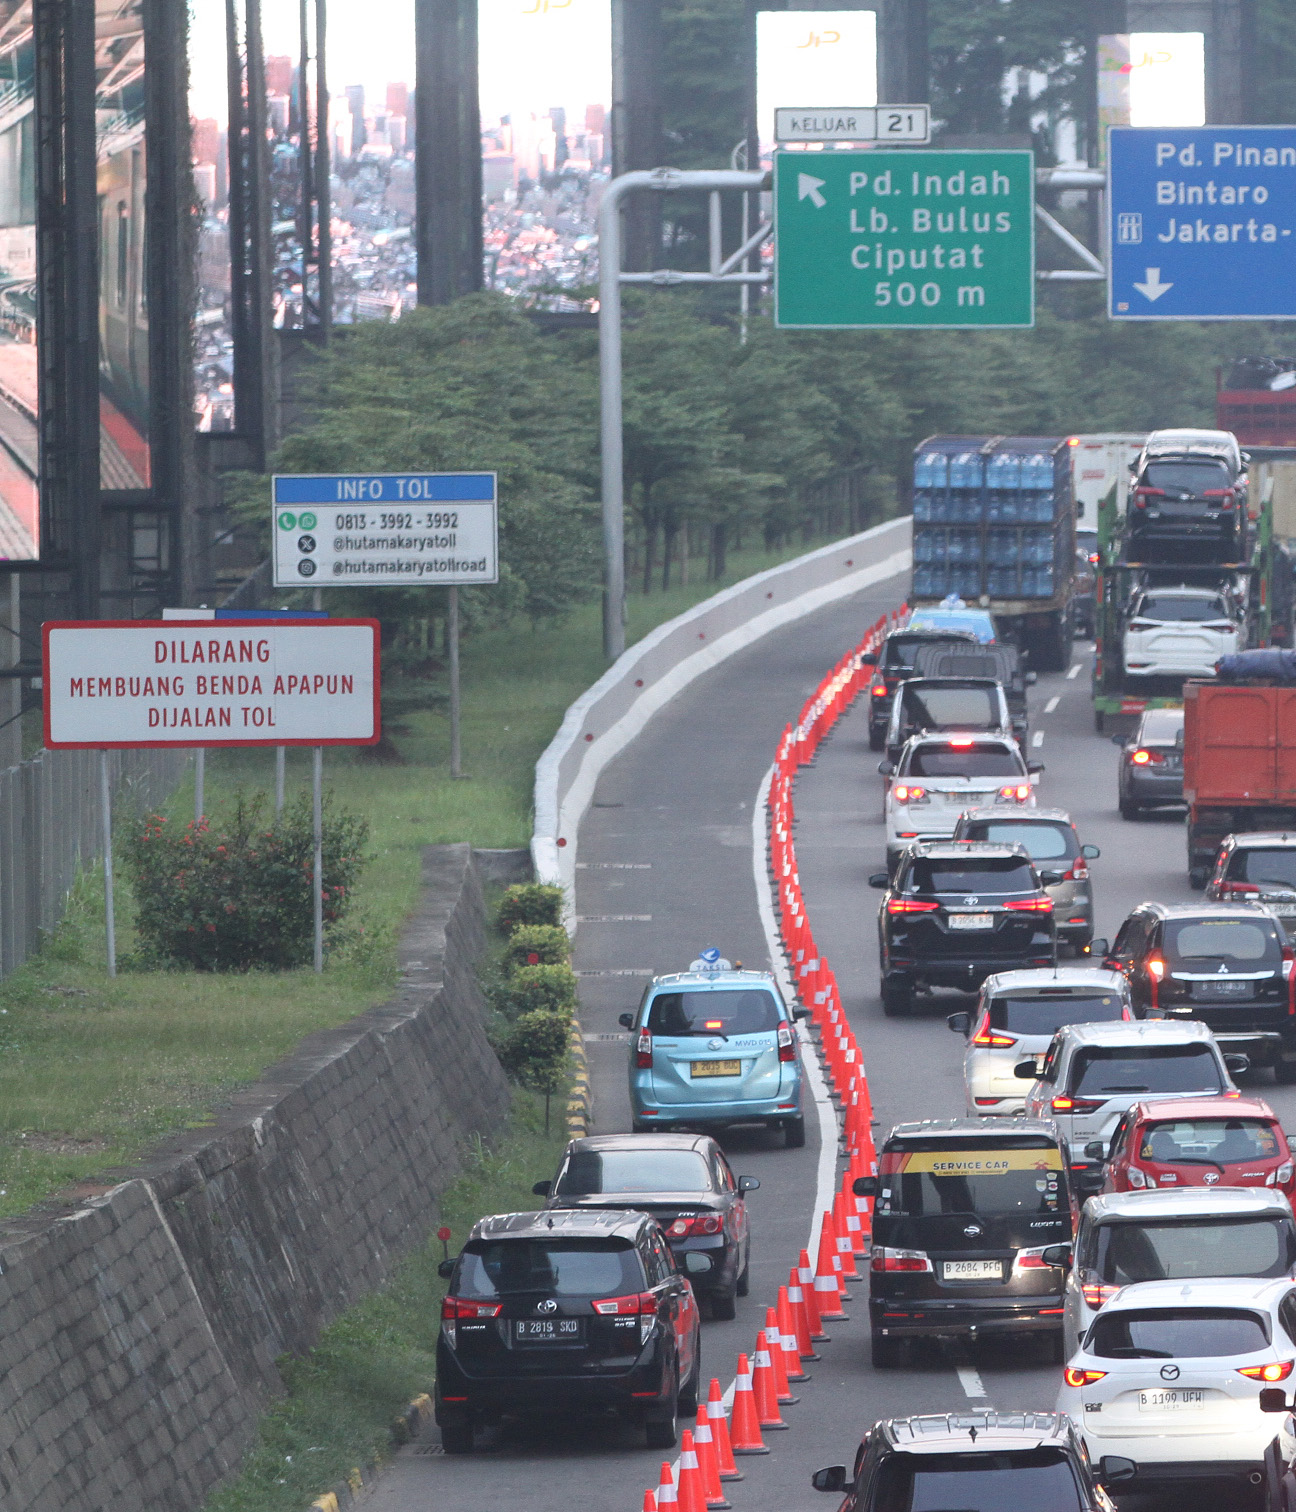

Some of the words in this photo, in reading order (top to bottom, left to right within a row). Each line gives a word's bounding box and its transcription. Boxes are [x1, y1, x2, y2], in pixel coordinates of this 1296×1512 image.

[791, 117, 857, 132] KELUAR
[888, 115, 914, 132] 21
[1156, 142, 1203, 167] Pd.
[850, 170, 902, 196] Pd.
[912, 170, 1010, 196] Indah
[1156, 180, 1269, 205] Bintaro
[850, 207, 899, 233] Lb.
[912, 207, 1012, 233] Bulus
[851, 243, 984, 276] Ciputat
[874, 282, 942, 307] 500
[957, 284, 986, 307] m
[337, 480, 383, 499] INFO
[396, 479, 432, 498] TOL
[335, 514, 367, 531] 0813
[379, 514, 412, 530] 3992
[426, 512, 458, 529] 3992
[333, 534, 457, 553] @hutamakaryatoll
[332, 557, 487, 577] @hutamakaryatollroad
[154, 640, 271, 664] DILARANG
[70, 676, 185, 698] MEMBUANG
[196, 675, 263, 696] BENDA
[273, 674, 353, 695] APAPUN
[148, 707, 232, 728] DIJALAN
[241, 706, 276, 727] TOL
[933, 1161, 982, 1171] SERVICE
[986, 1161, 1009, 1169] CAR
[945, 1263, 951, 1273] B
[955, 1262, 978, 1273] 2684
[983, 1262, 1000, 1272] PFG
[519, 1322, 525, 1333] B
[530, 1322, 554, 1333] 2819
[560, 1321, 577, 1332] SKD
[1140, 1393, 1148, 1405] B
[1152, 1393, 1177, 1405] 1199
[1182, 1392, 1202, 1403] UFW
